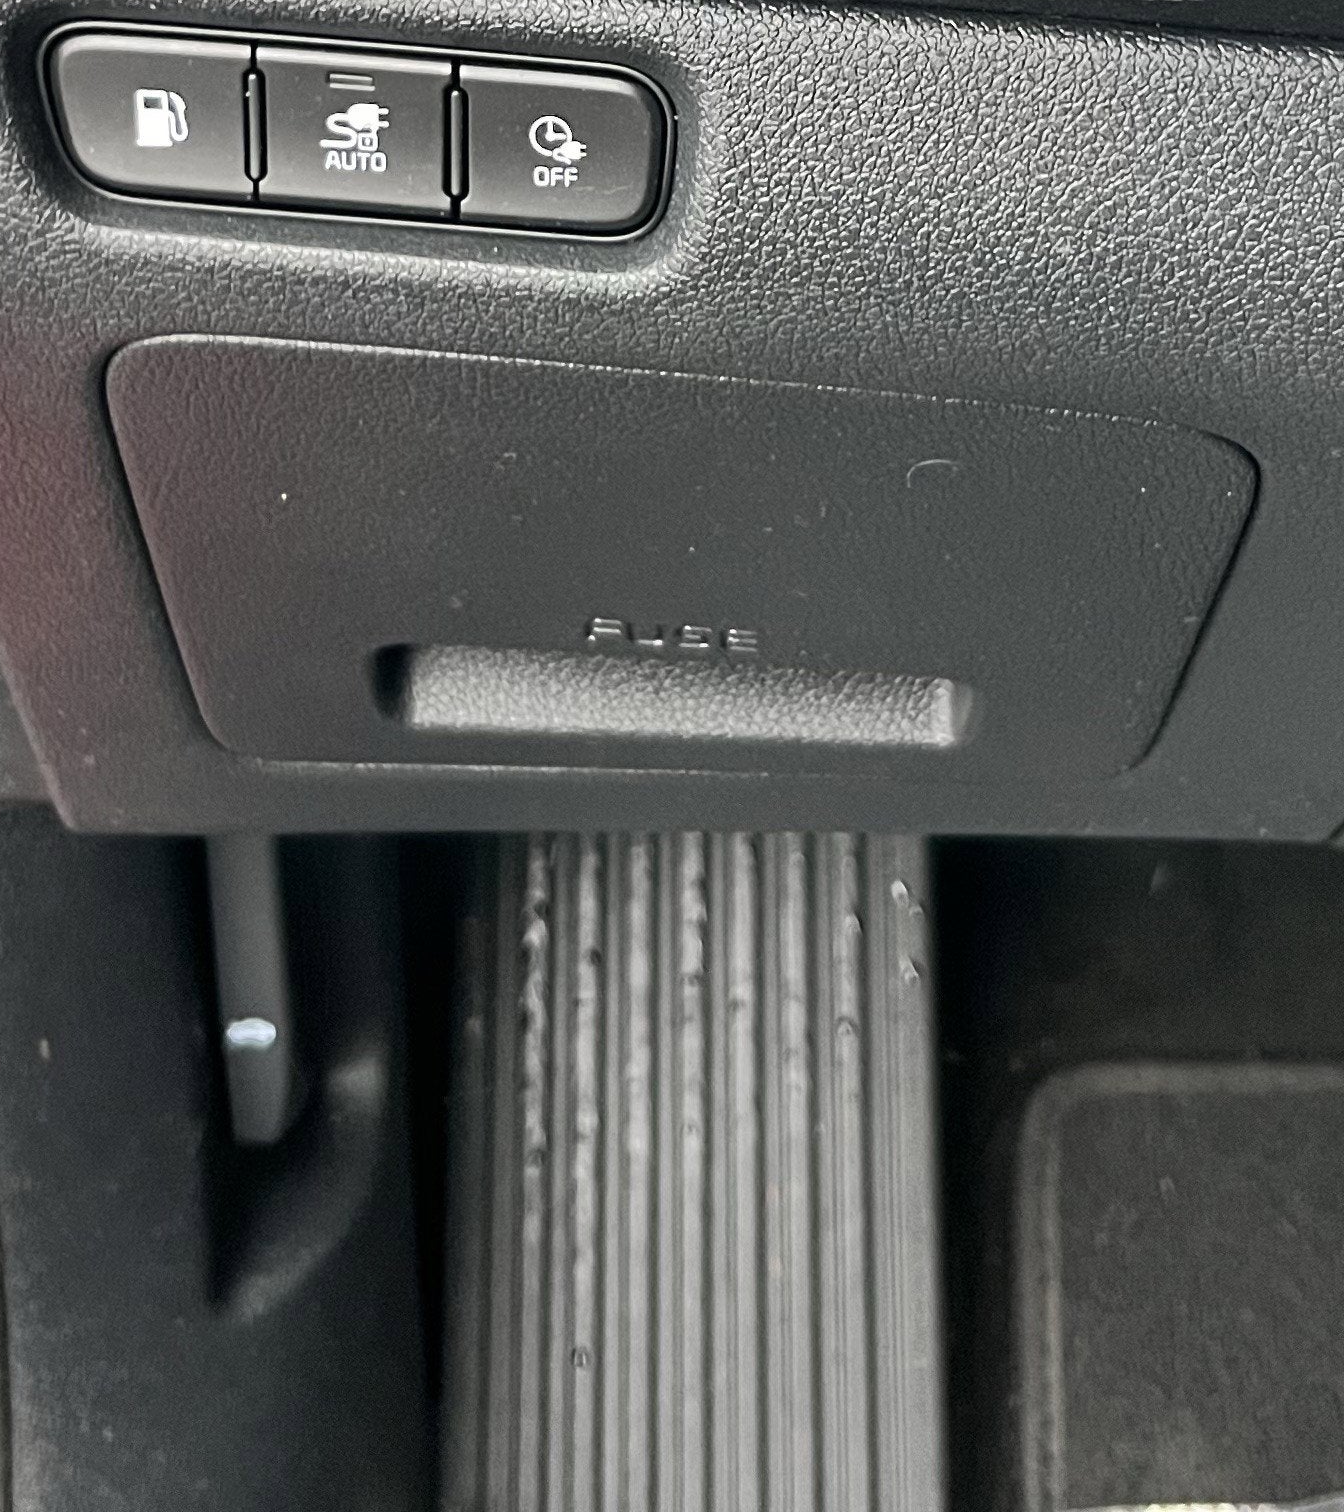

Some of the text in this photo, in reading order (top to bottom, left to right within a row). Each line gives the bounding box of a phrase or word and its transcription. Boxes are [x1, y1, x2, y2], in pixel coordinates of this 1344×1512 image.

[324, 149, 388, 173] AUTO
[532, 165, 579, 188] OFF
[586, 616, 758, 653] FUSE
